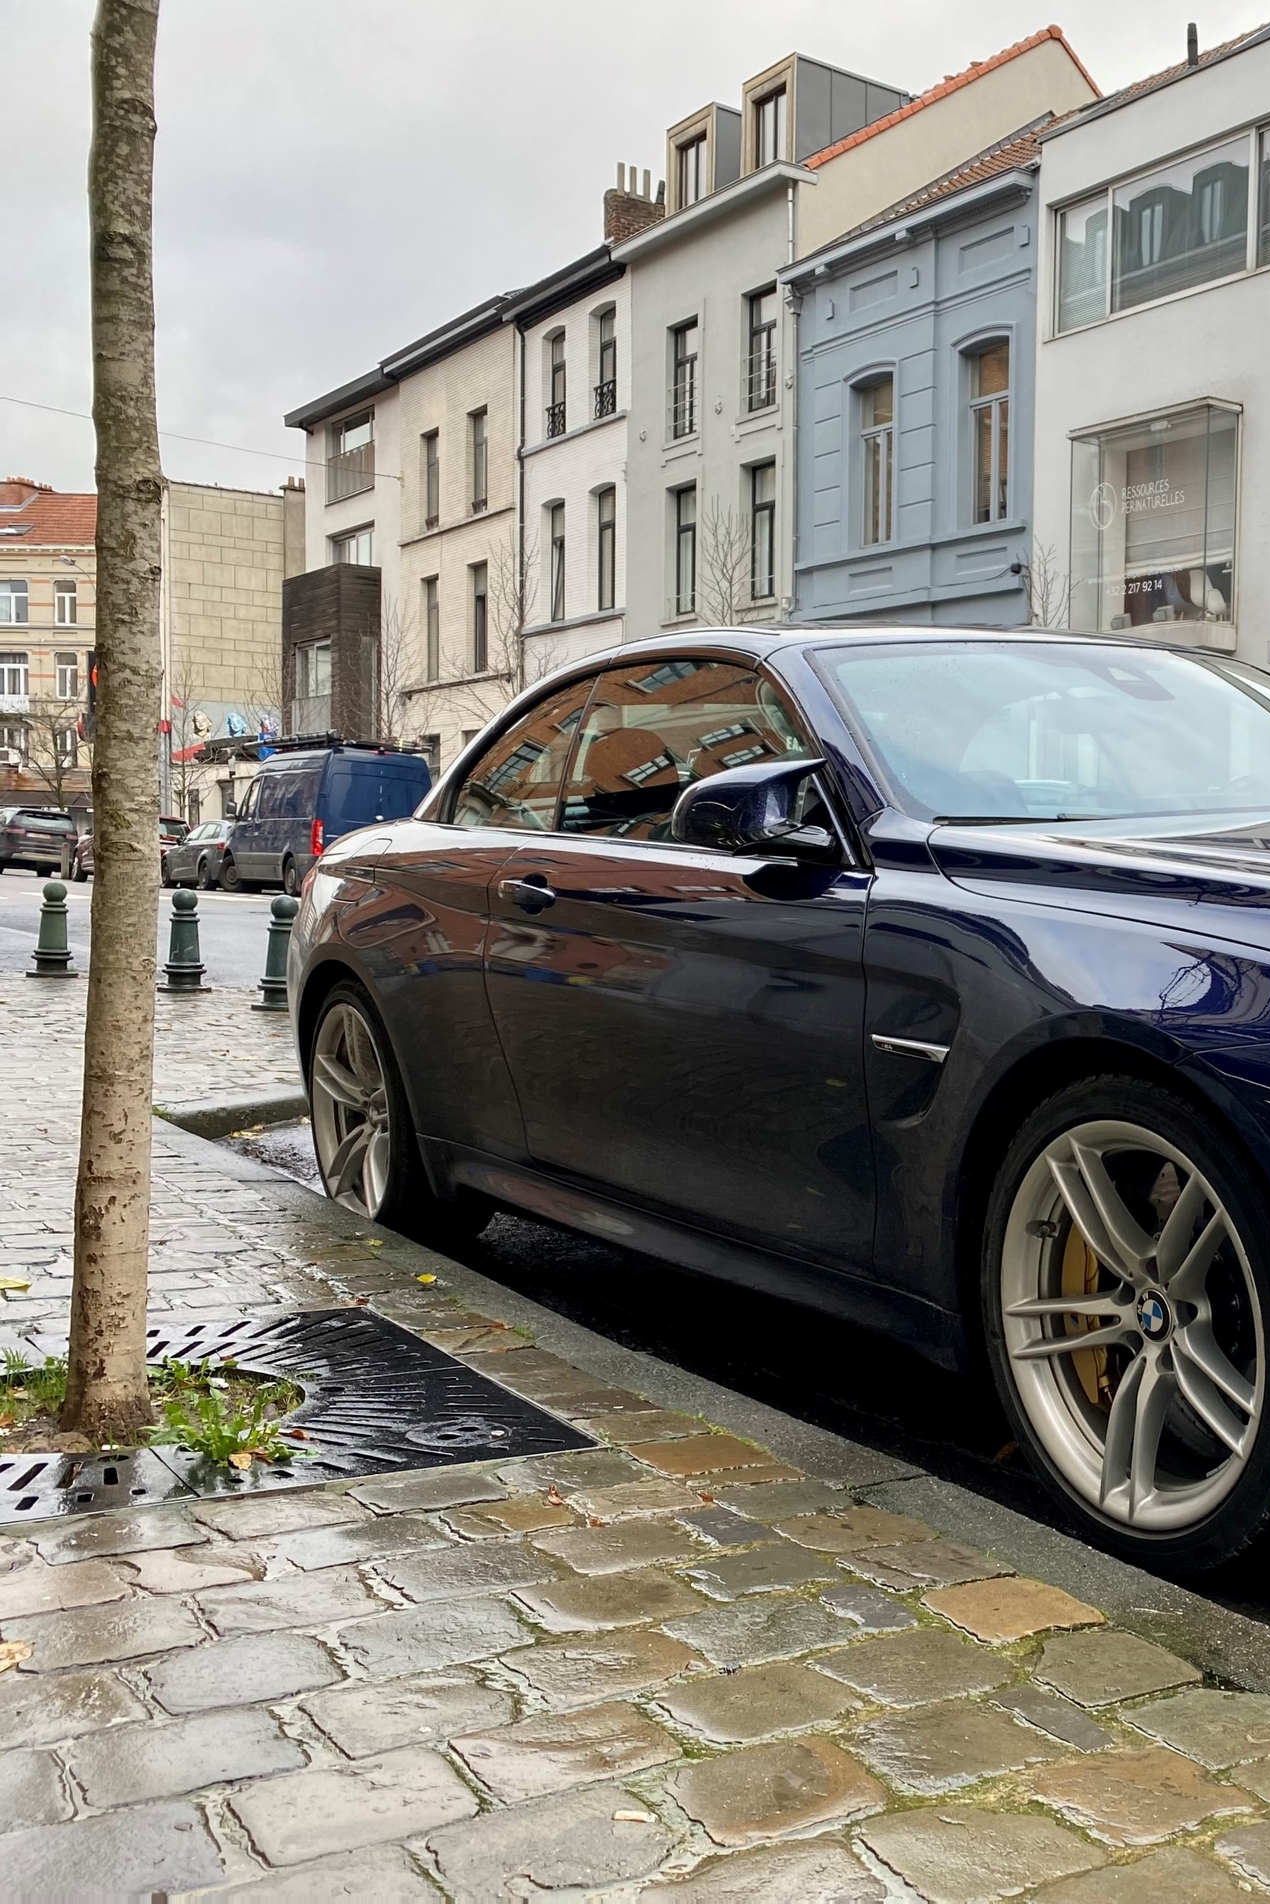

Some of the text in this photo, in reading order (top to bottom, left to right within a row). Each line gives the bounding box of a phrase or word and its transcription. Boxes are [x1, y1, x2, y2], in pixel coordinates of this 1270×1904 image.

[1121, 479, 1170, 500] RESSOURCES
[1122, 584, 1127, 595] 2
[1128, 582, 1141, 595] 217
[1142, 580, 1153, 592] 92
[1154, 579, 1163, 590] 14
